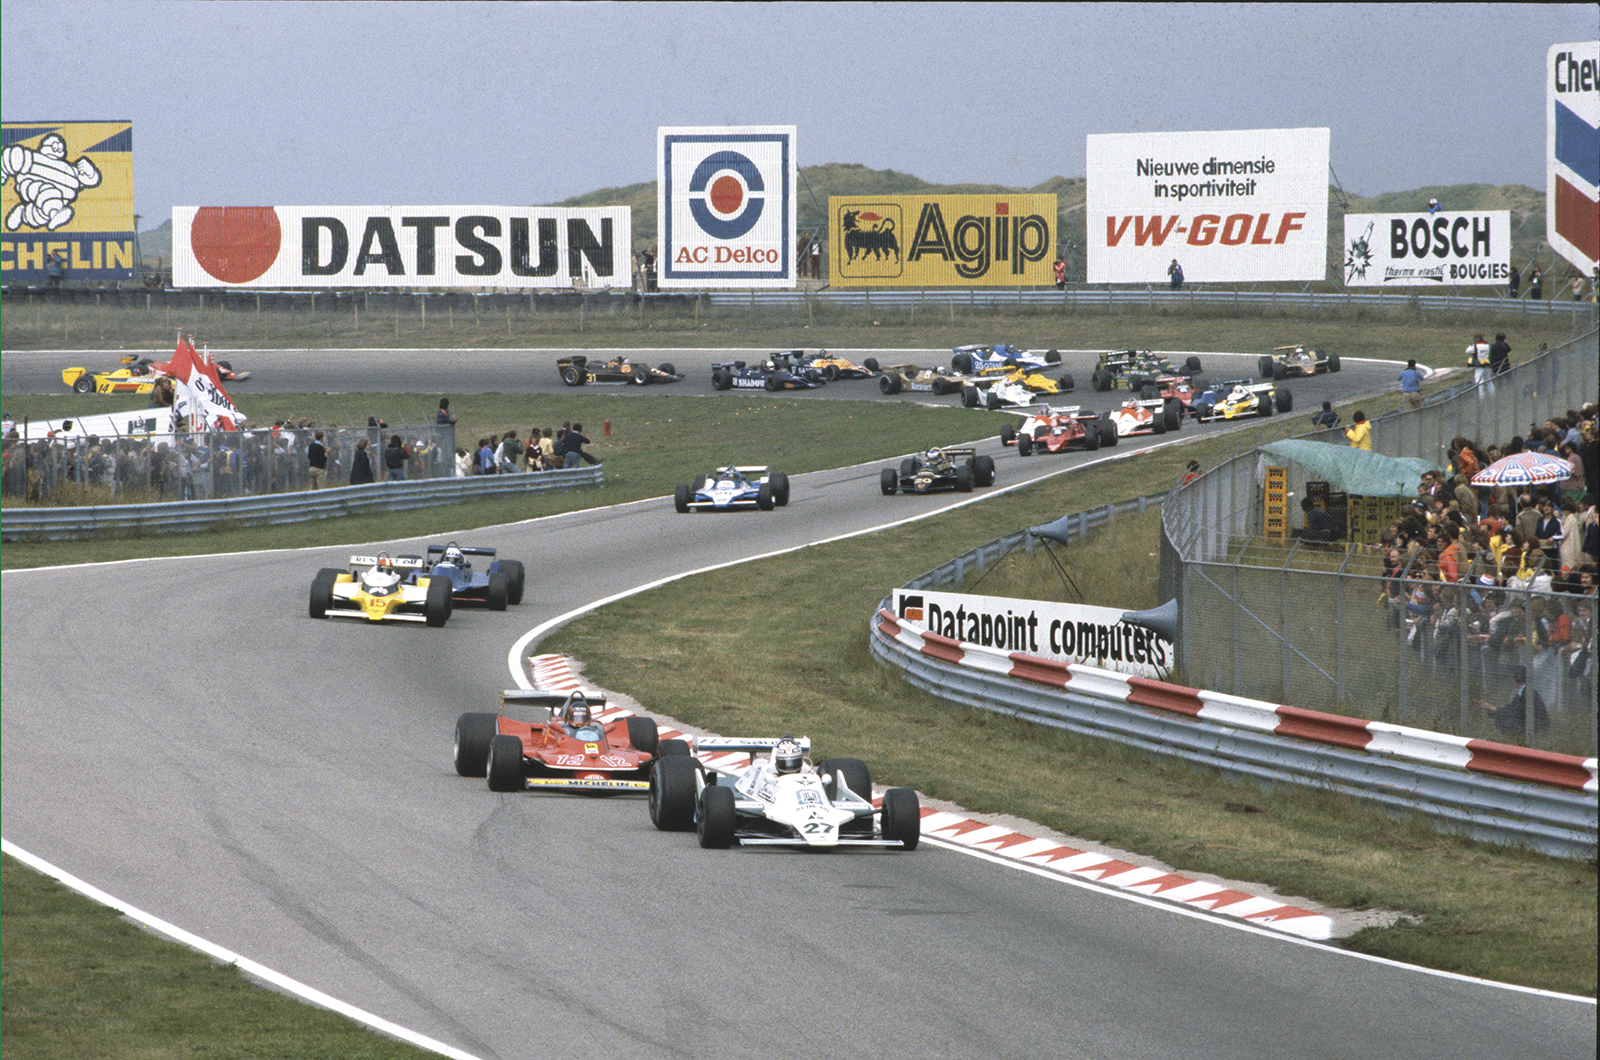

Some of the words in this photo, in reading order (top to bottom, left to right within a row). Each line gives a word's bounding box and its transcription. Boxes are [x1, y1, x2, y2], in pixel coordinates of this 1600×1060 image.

[1137, 159, 1198, 176] Nieuwe
[1203, 156, 1275, 175] dimensie
[1155, 180, 1168, 197] in
[1171, 179, 1256, 201] sportiviteit
[1106, 212, 1307, 247] VW-GOLF
[1391, 217, 1490, 259] BOSCH
[301, 216, 613, 278] DATSUN
[907, 202, 1049, 279] Agip
[1, 241, 133, 270] CHELIN
[675, 247, 708, 264] AC
[714, 247, 779, 264] Delco
[1385, 266, 1415, 277] thermo
[1418, 264, 1446, 276] elastic
[1450, 263, 1508, 280] BOUGIES
[586, 373, 597, 382] 31
[98, 384, 110, 393] 14
[370, 598, 386, 607] 15
[928, 603, 1037, 653] Datapoint
[1050, 619, 1166, 668] computers
[557, 754, 585, 766] 12
[600, 755, 632, 767] 12
[803, 822, 834, 834] 27
